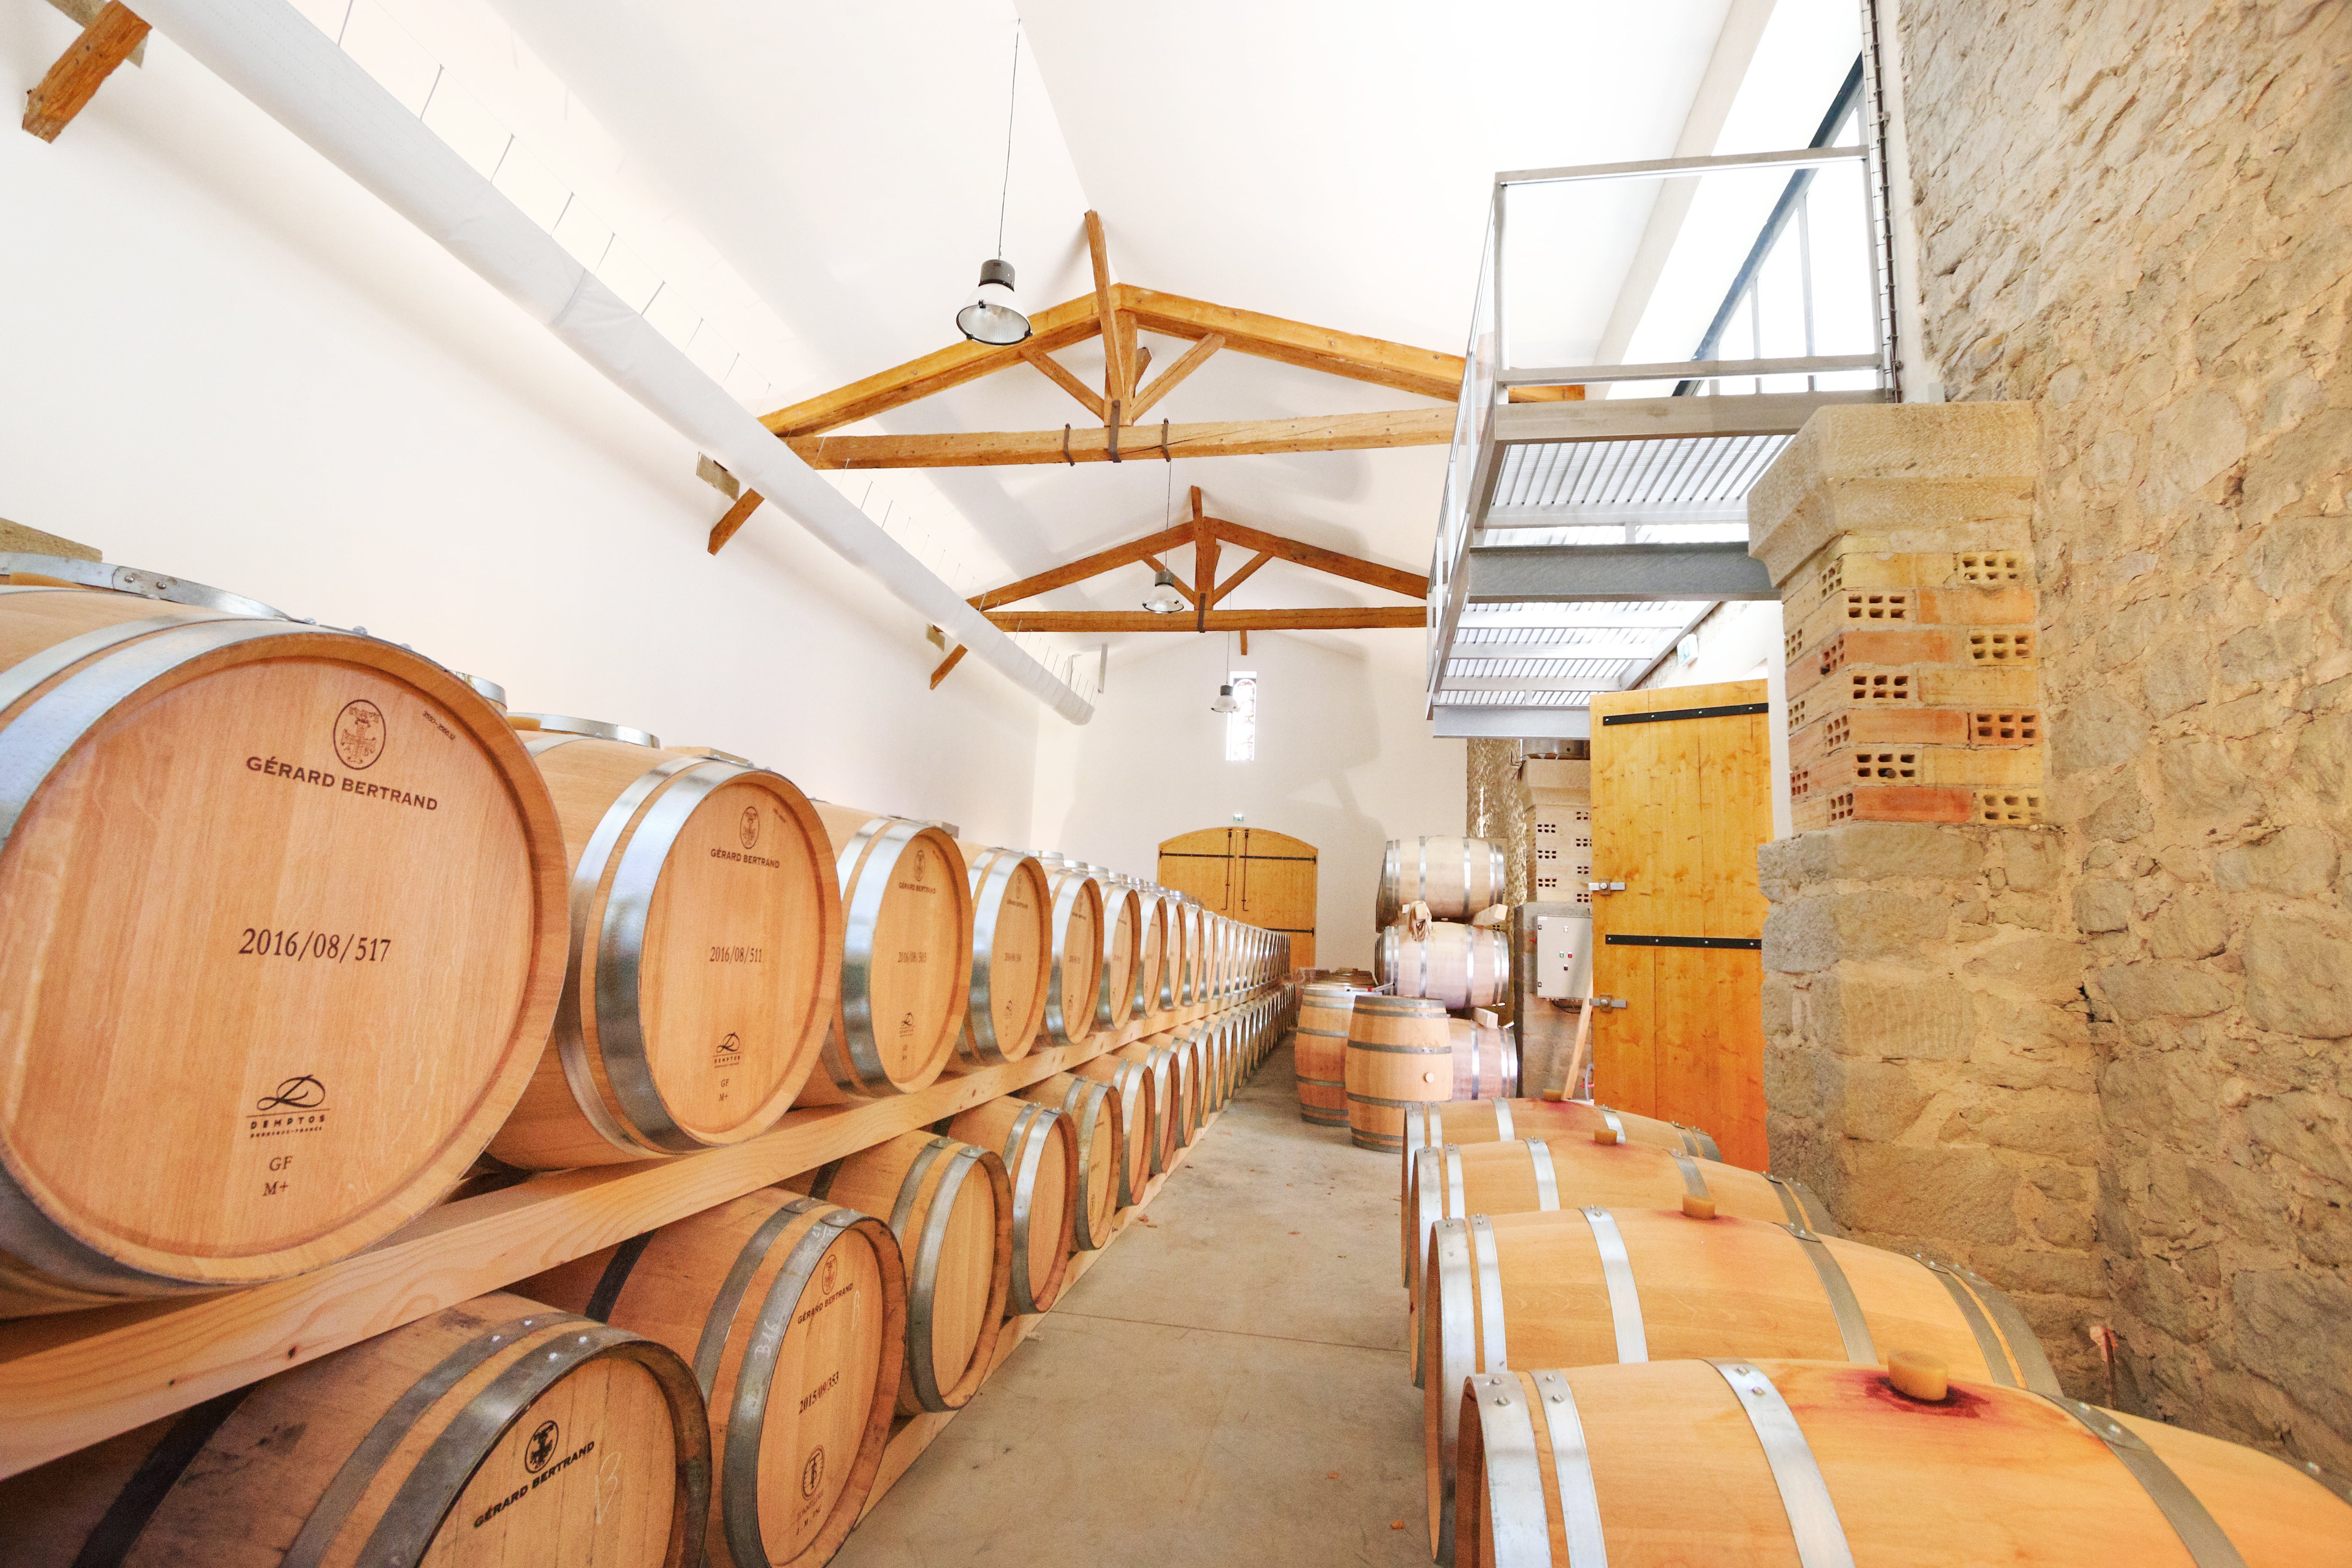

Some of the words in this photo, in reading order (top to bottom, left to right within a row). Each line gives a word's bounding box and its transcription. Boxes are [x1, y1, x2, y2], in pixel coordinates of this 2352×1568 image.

[246, 756, 335, 787] GÉRARD
[341, 778, 438, 811] BERTRAND
[710, 847, 741, 861] GÉRARD
[743, 854, 780, 868] BERTRAND
[239, 928, 392, 963] 2016/08/517
[710, 945, 762, 964] 2016/08/511
[269, 1155, 293, 1171] GF
[263, 1181, 289, 1197] M+
[798, 1302, 823, 1324] GÉRARD
[825, 1283, 853, 1308] BERTRAND
[474, 1485, 528, 1529] GÉRARD
[532, 1441, 595, 1489] BERTRAND
